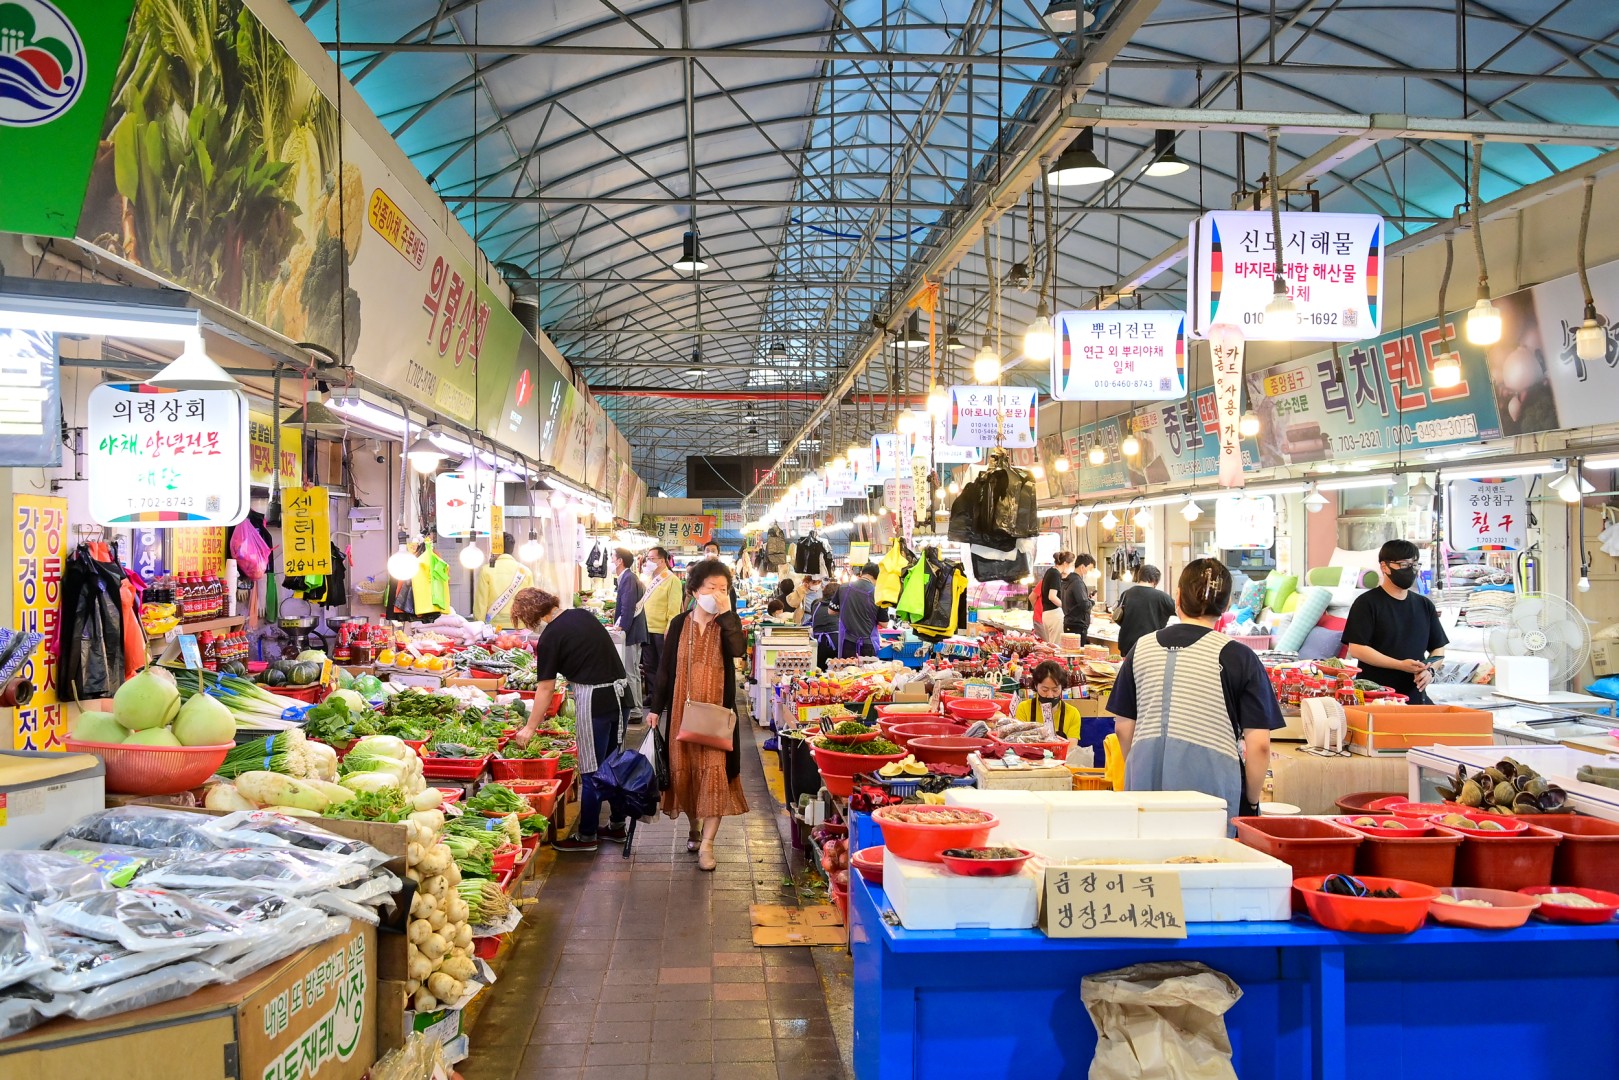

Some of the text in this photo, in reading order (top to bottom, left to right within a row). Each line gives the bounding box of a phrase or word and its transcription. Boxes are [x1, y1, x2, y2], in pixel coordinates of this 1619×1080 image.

[372, 196, 426, 266] 각종야채 주문배달
[1313, 264, 1357, 284] 해산물
[423, 255, 492, 376] 의령상회
[1090, 322, 1157, 340] 뿌리전문
[1083, 345, 1164, 360] 연근 외 뿌리야채
[1113, 361, 1135, 375] 일체
[1316, 323, 1471, 423] 리치랜드
[1094, 380, 1153, 388] 010-6460-8743
[1269, 370, 1306, 395] 중앙침구
[1224, 385, 1238, 416] 사용
[112, 398, 206, 423] 의령상회
[1222, 425, 1237, 455] 가능
[1477, 485, 1506, 493] 리치랜드
[128, 497, 194, 508] T.702-8743
[1469, 494, 1514, 507] 중앙침구
[656, 522, 704, 538] 경북상회
[286, 558, 328, 574] 있습니다
[264, 935, 365, 1036] 내일 또 방문하고 싶은
